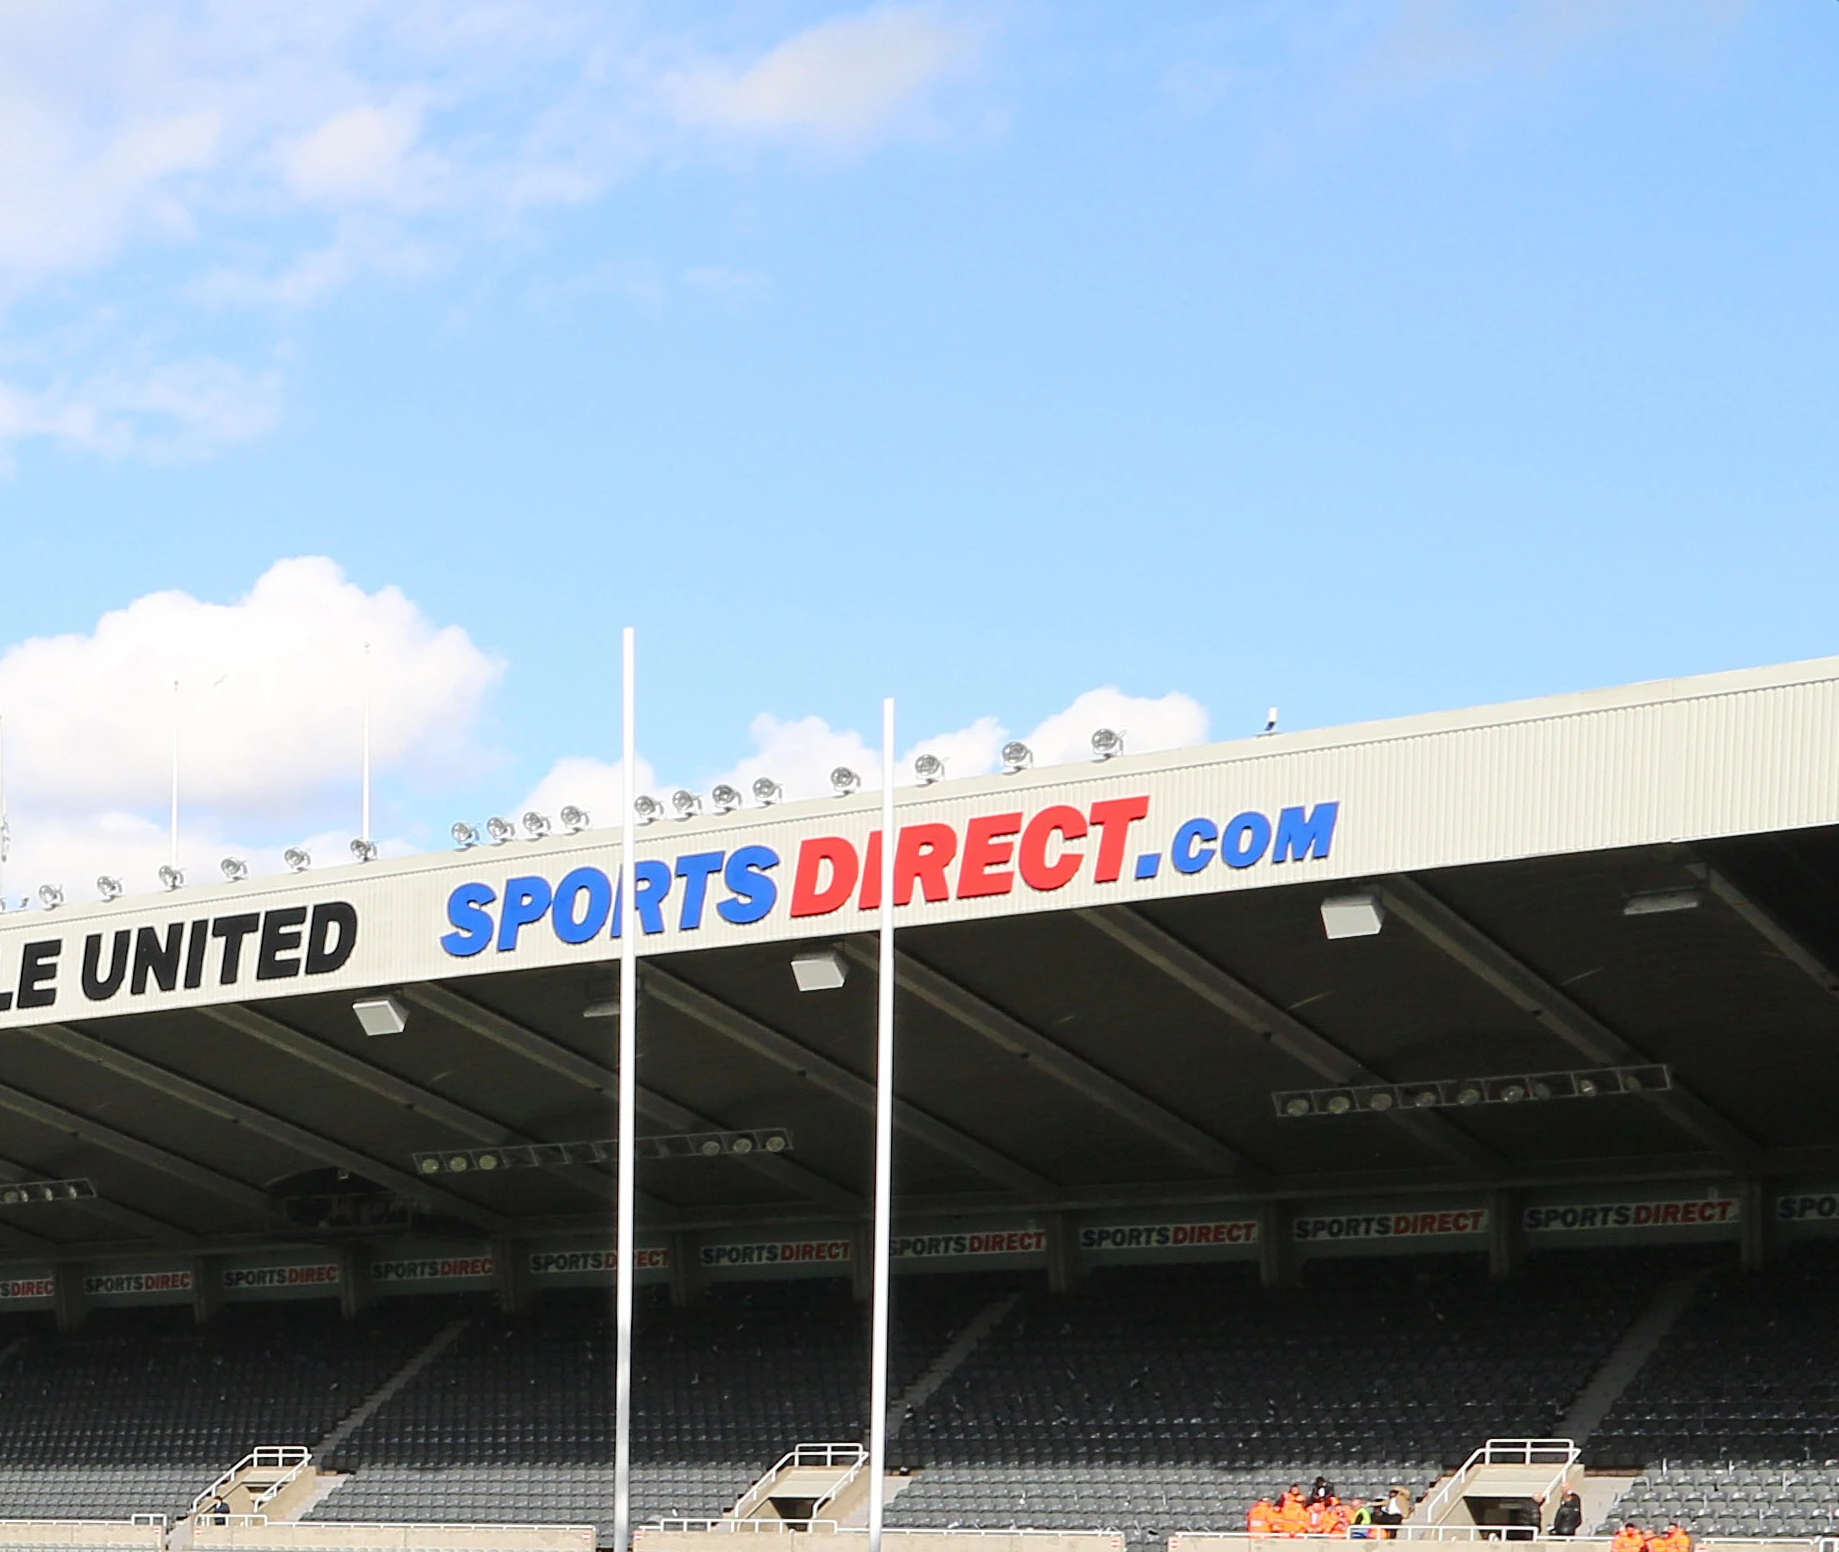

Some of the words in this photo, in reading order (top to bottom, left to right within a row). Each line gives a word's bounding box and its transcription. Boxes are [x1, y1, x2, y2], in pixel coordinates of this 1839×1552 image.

[79, 901, 359, 1000] UNITED
[224, 1266, 339, 1287] SPORTSDIREC
[372, 1257, 494, 1279] SPORTSDIREC
[84, 1275, 192, 1293] SPORTSDIREC
